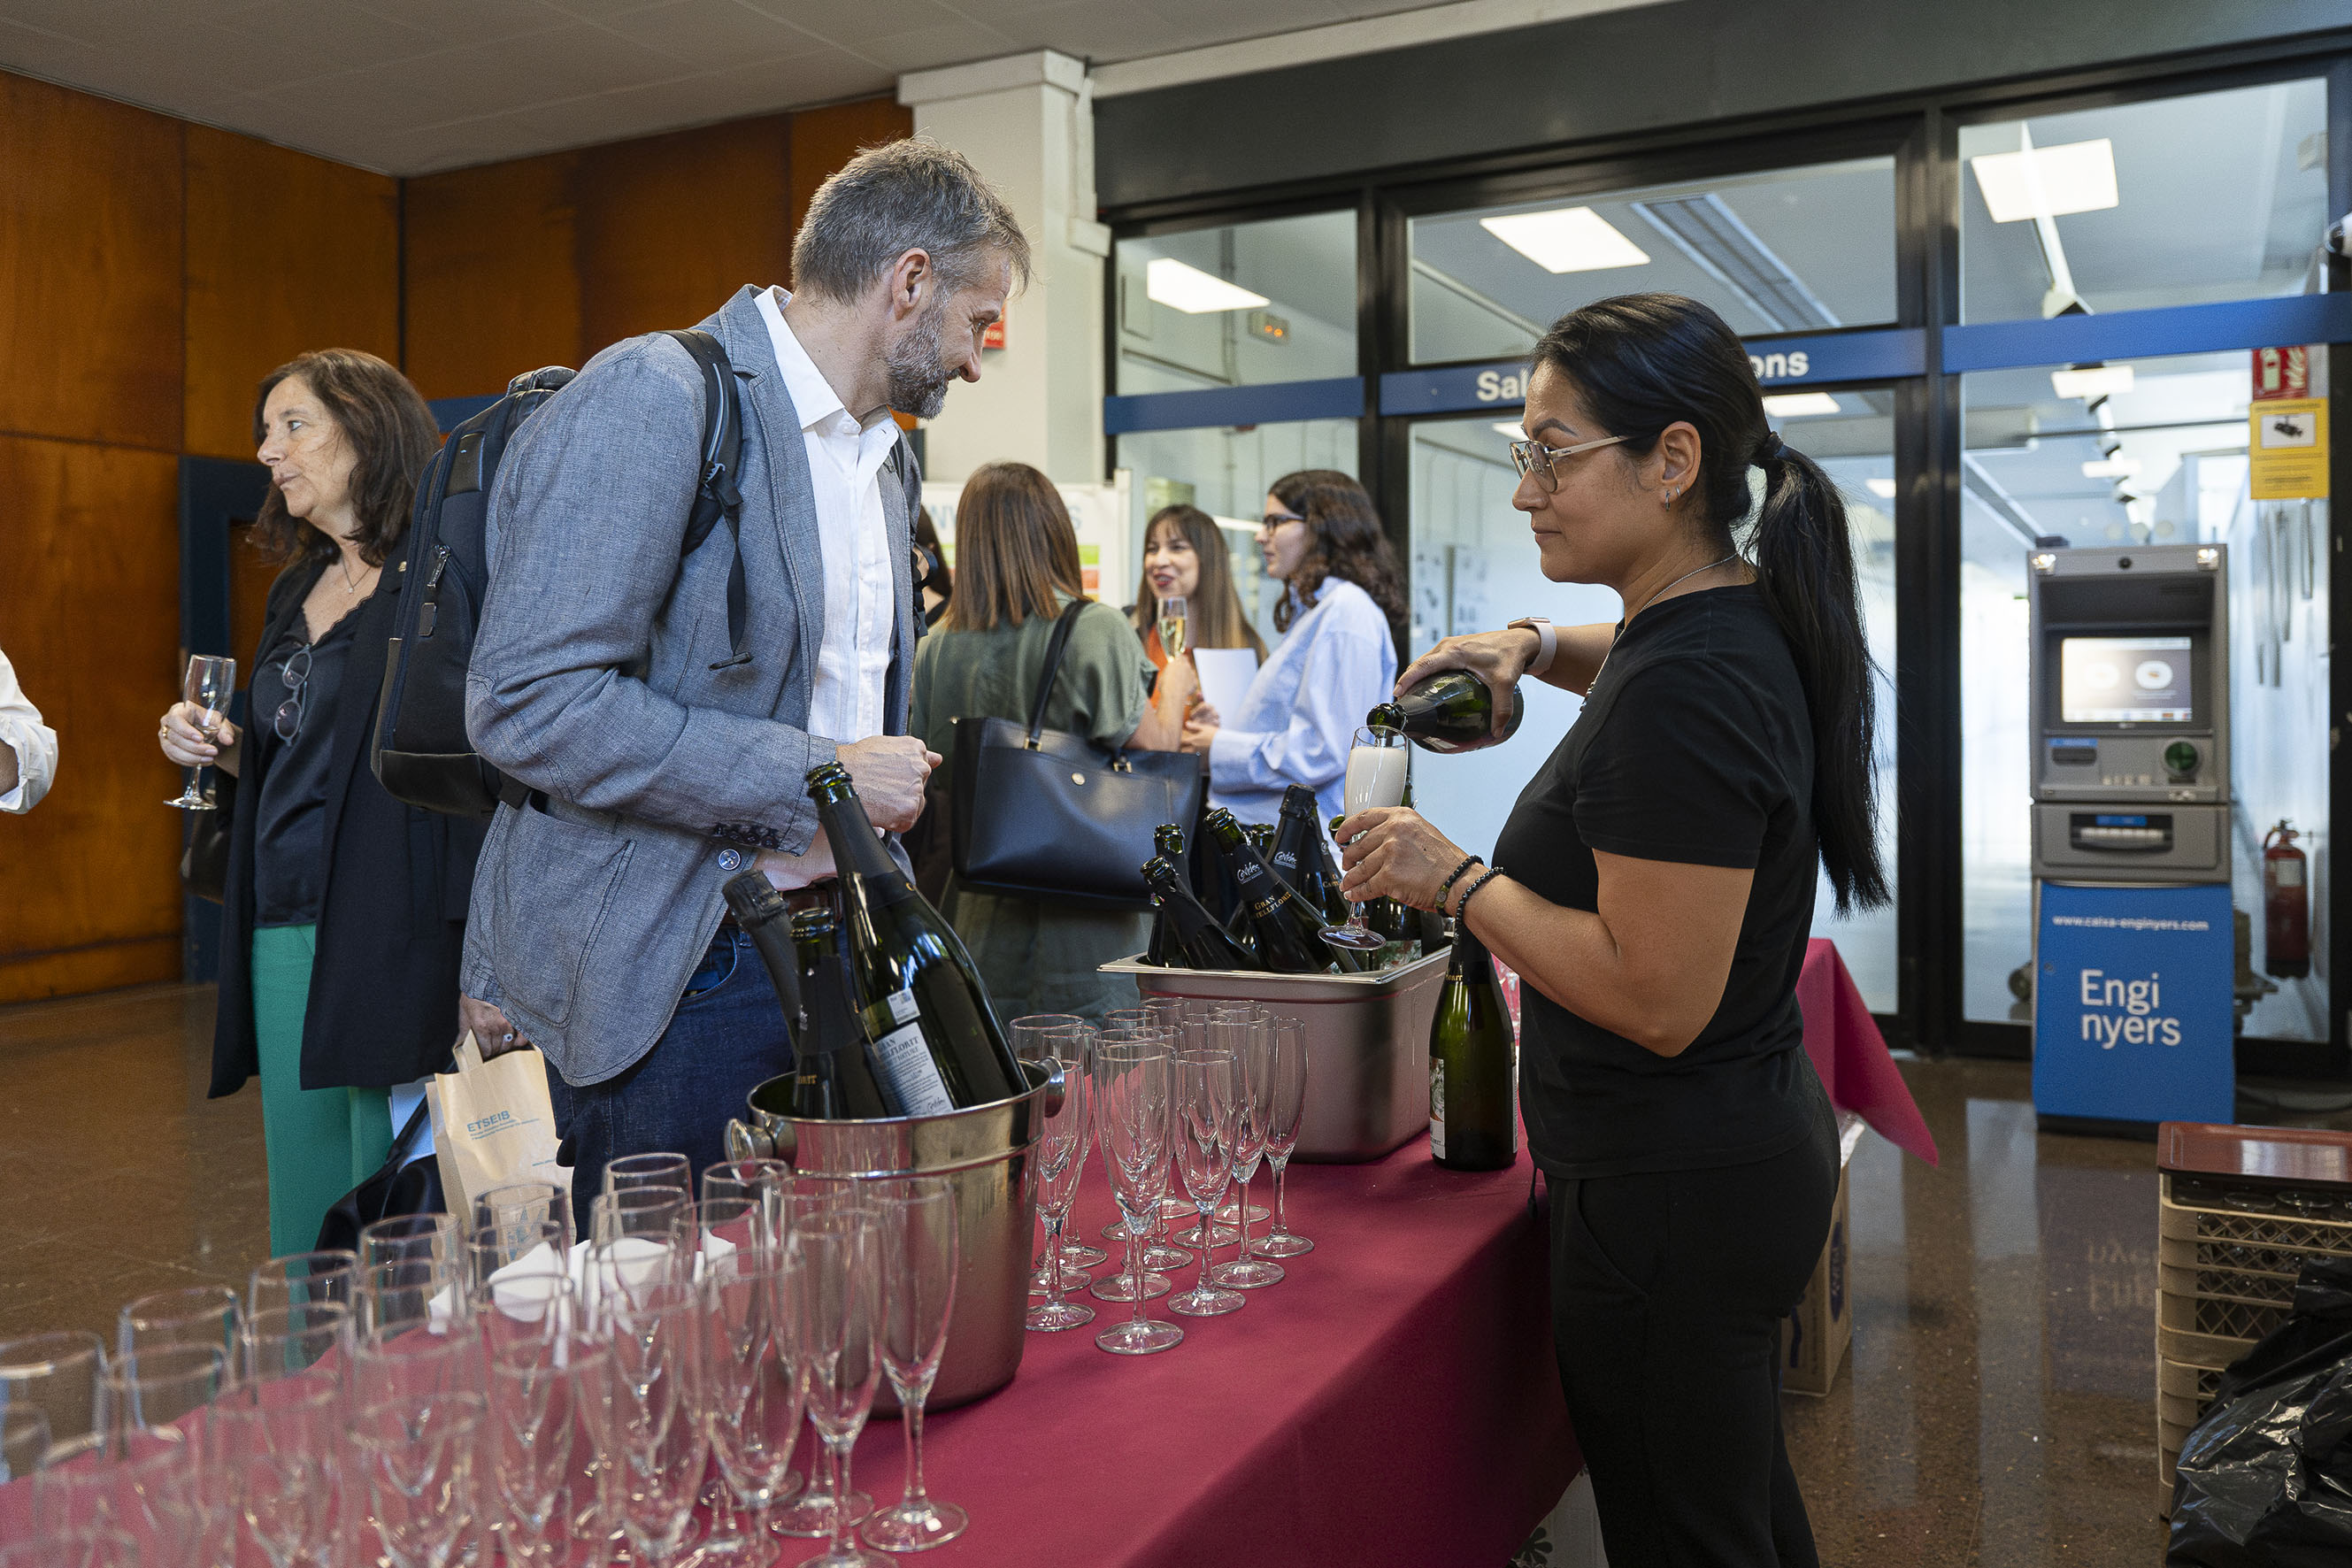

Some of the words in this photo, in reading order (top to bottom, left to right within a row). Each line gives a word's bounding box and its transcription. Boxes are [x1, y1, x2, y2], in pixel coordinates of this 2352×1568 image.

[1477, 368, 1526, 402] Sal
[1749, 350, 1810, 380] ons
[2052, 915, 2210, 931] www.caixa-enginyers.com
[2080, 969, 2160, 1016] Engi
[2081, 1013, 2182, 1050] nyers
[467, 1111, 511, 1132] ETSEIB
